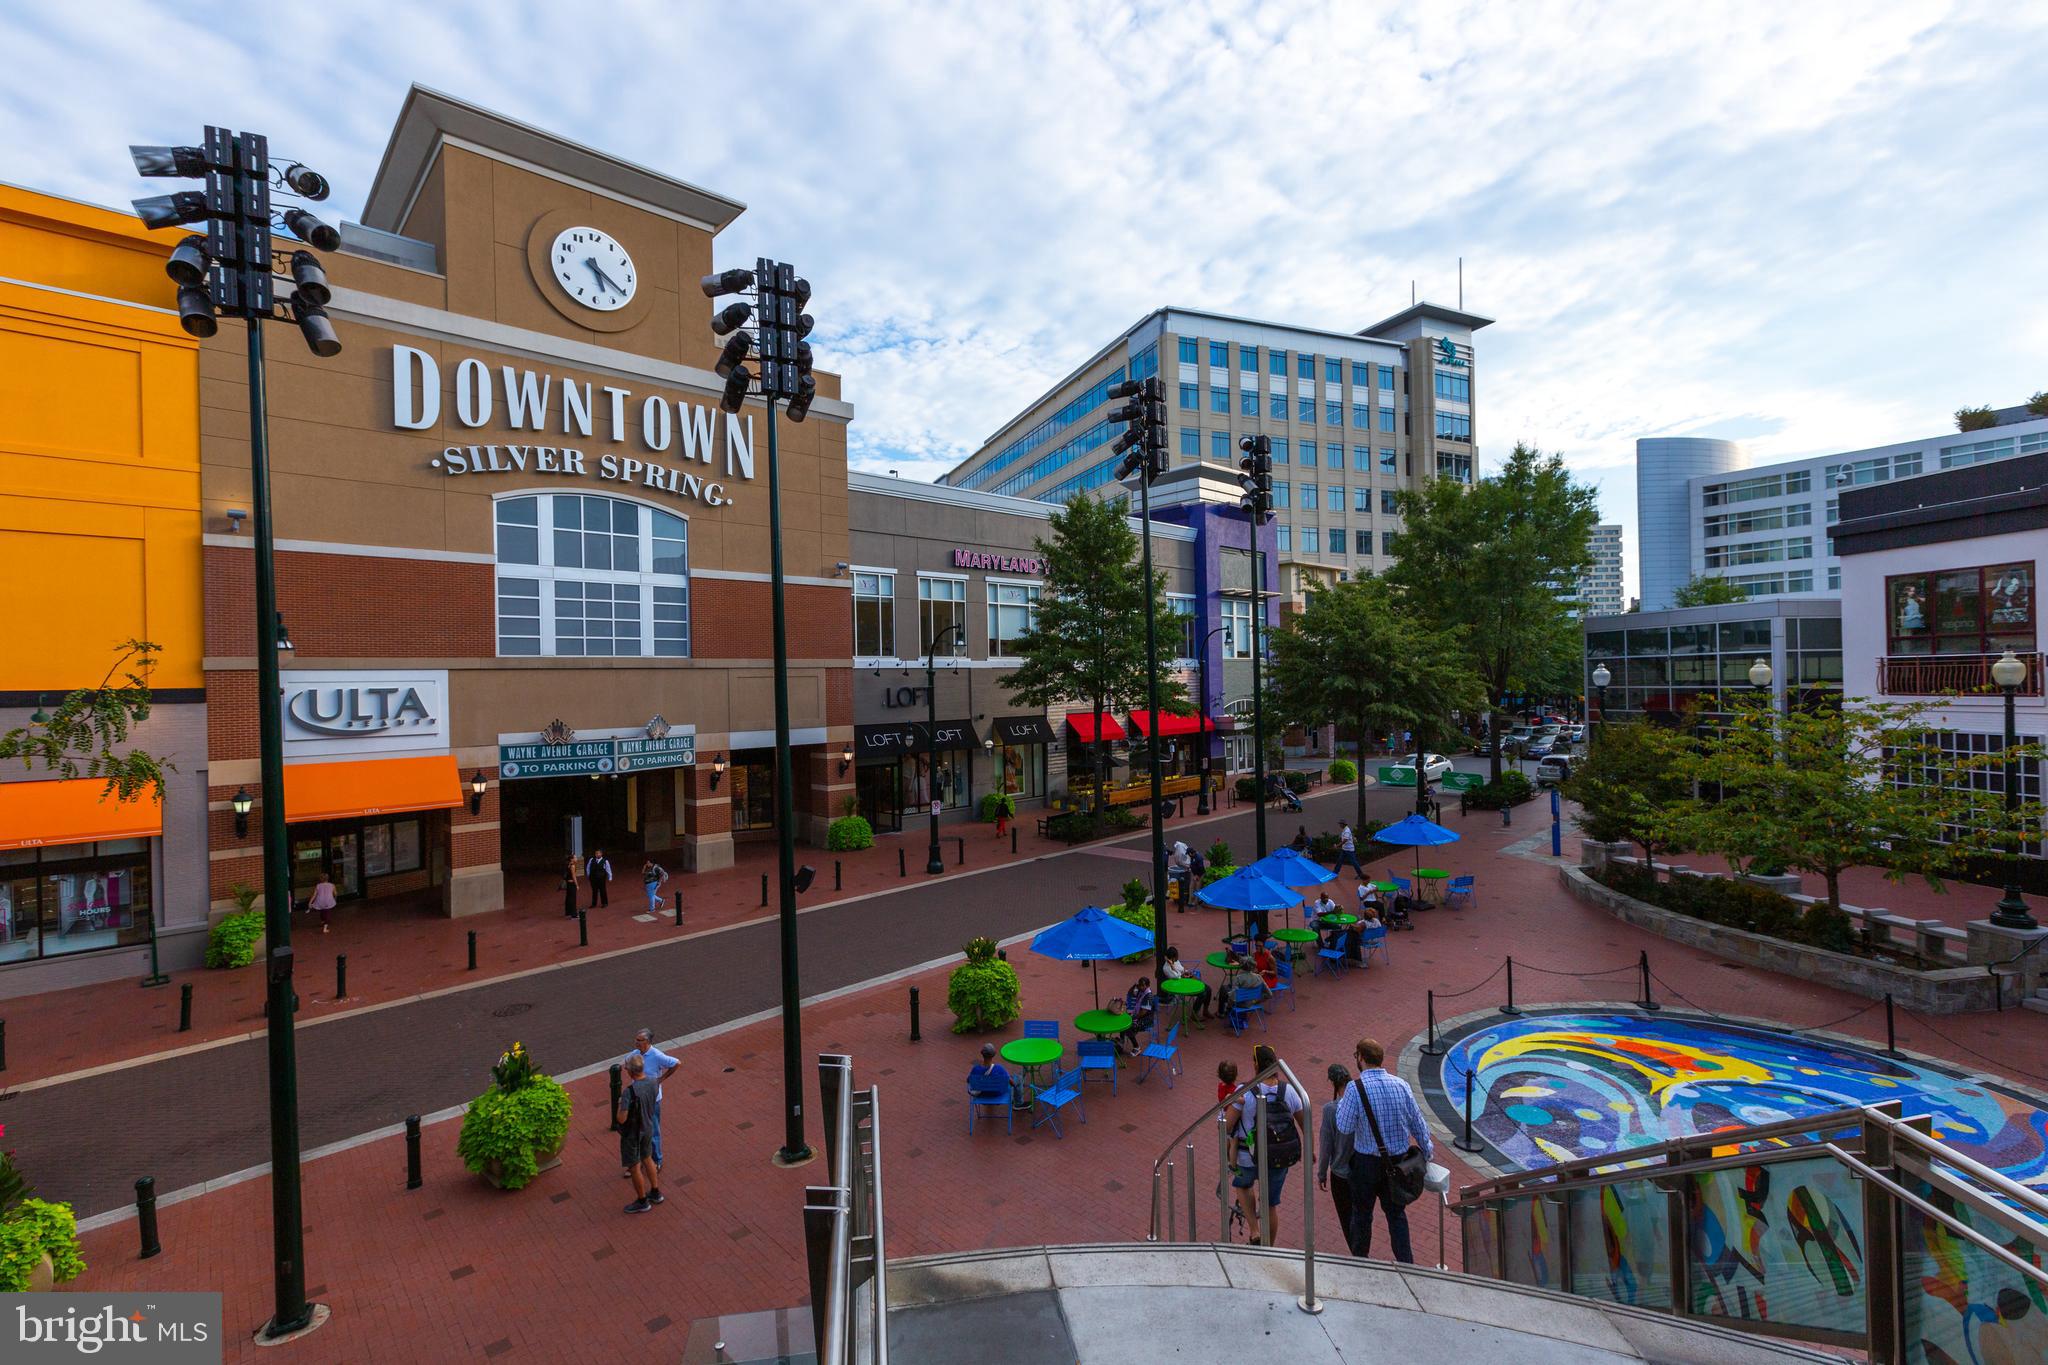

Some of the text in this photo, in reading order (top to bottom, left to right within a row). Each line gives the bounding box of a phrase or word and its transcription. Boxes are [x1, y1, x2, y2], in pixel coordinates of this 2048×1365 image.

[393, 344, 755, 480] DOWNTOWN
[443, 445, 588, 475] SILVER
[954, 548, 1038, 574] MARYLAND
[308, 687, 430, 722] ULTA
[1009, 724, 1038, 736] LOFT
[622, 737, 690, 753] WAYNE AVENUE GARAGE
[864, 733, 901, 747] LOFT
[507, 743, 608, 759] WAYNE AVENUE GARAGE
[522, 761, 596, 773] TO PARKING
[632, 754, 682, 766] TO PARKING
[79, 906, 111, 916] HOURS
